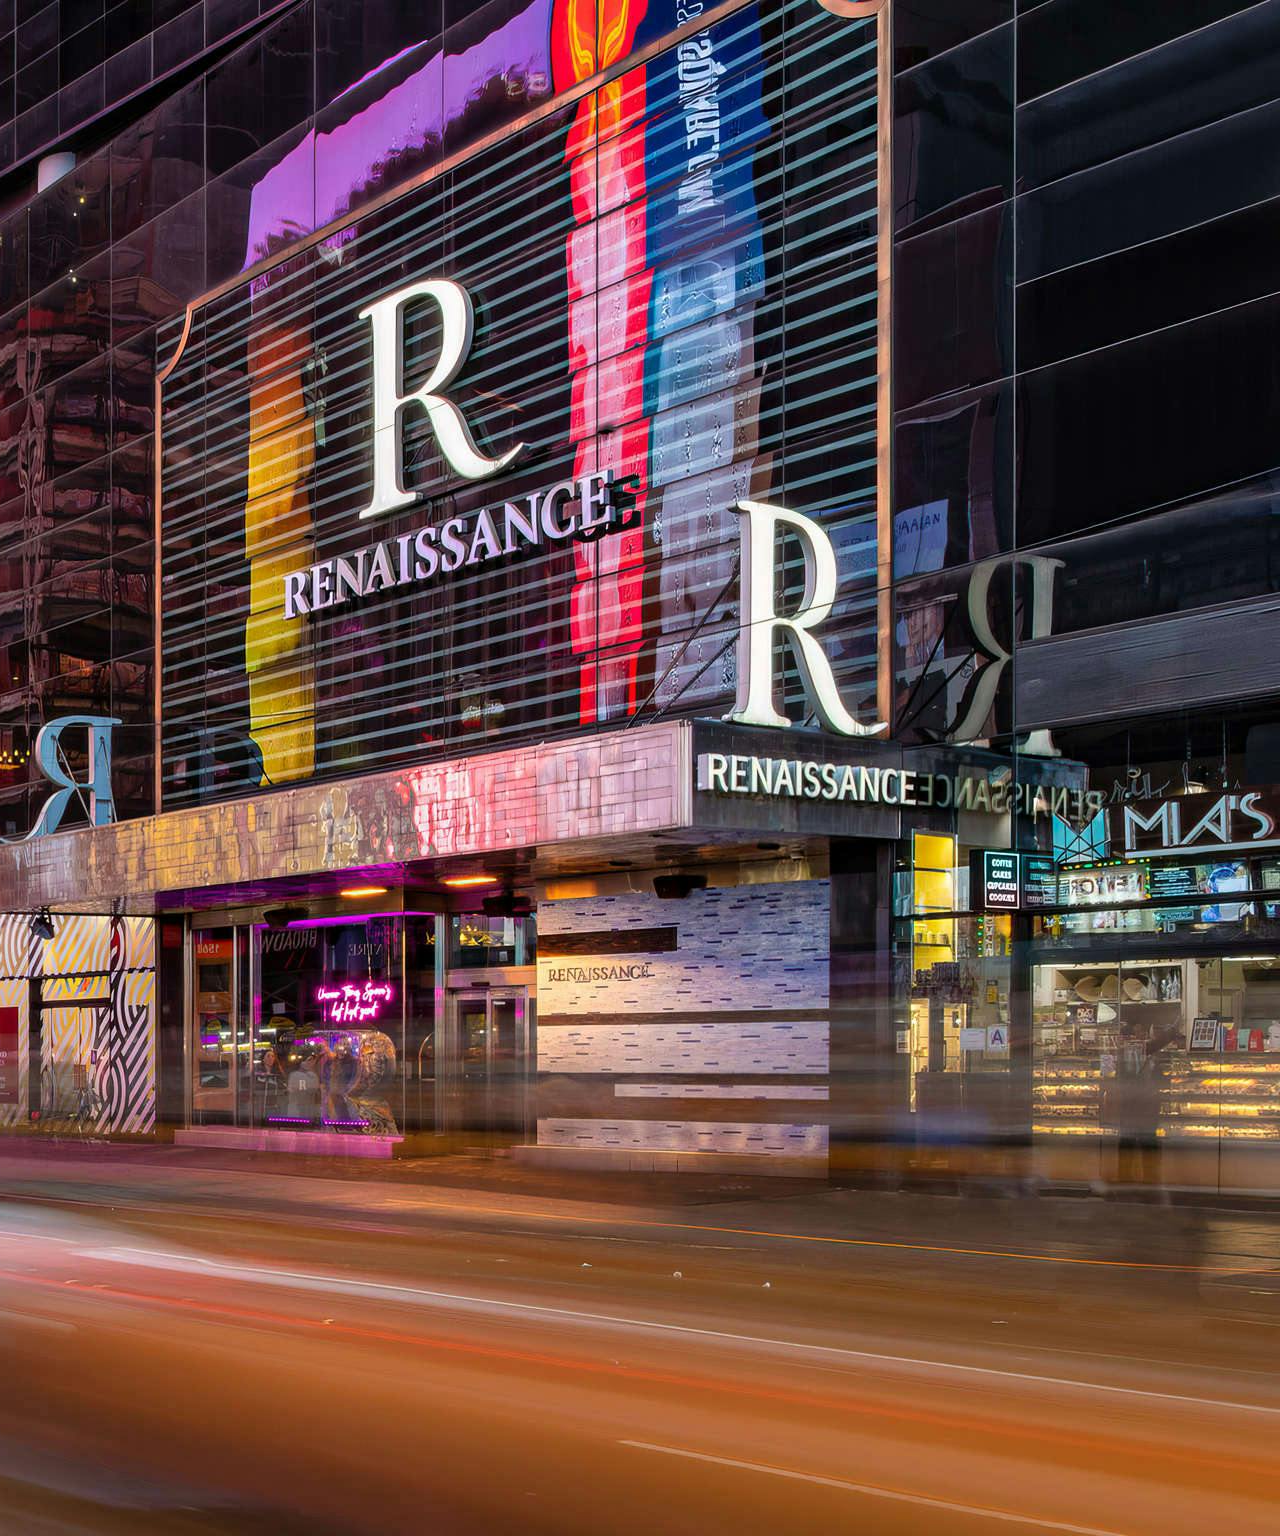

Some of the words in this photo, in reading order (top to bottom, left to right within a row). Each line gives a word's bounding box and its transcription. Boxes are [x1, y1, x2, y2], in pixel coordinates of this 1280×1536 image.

[359, 279, 531, 519] R
[283, 469, 615, 621] RENAISSANCE
[722, 500, 888, 738] R
[700, 752, 919, 806] RENAISSANCE
[548, 965, 650, 982] RENAISSANCE
[991, 1029, 1004, 1045] A
